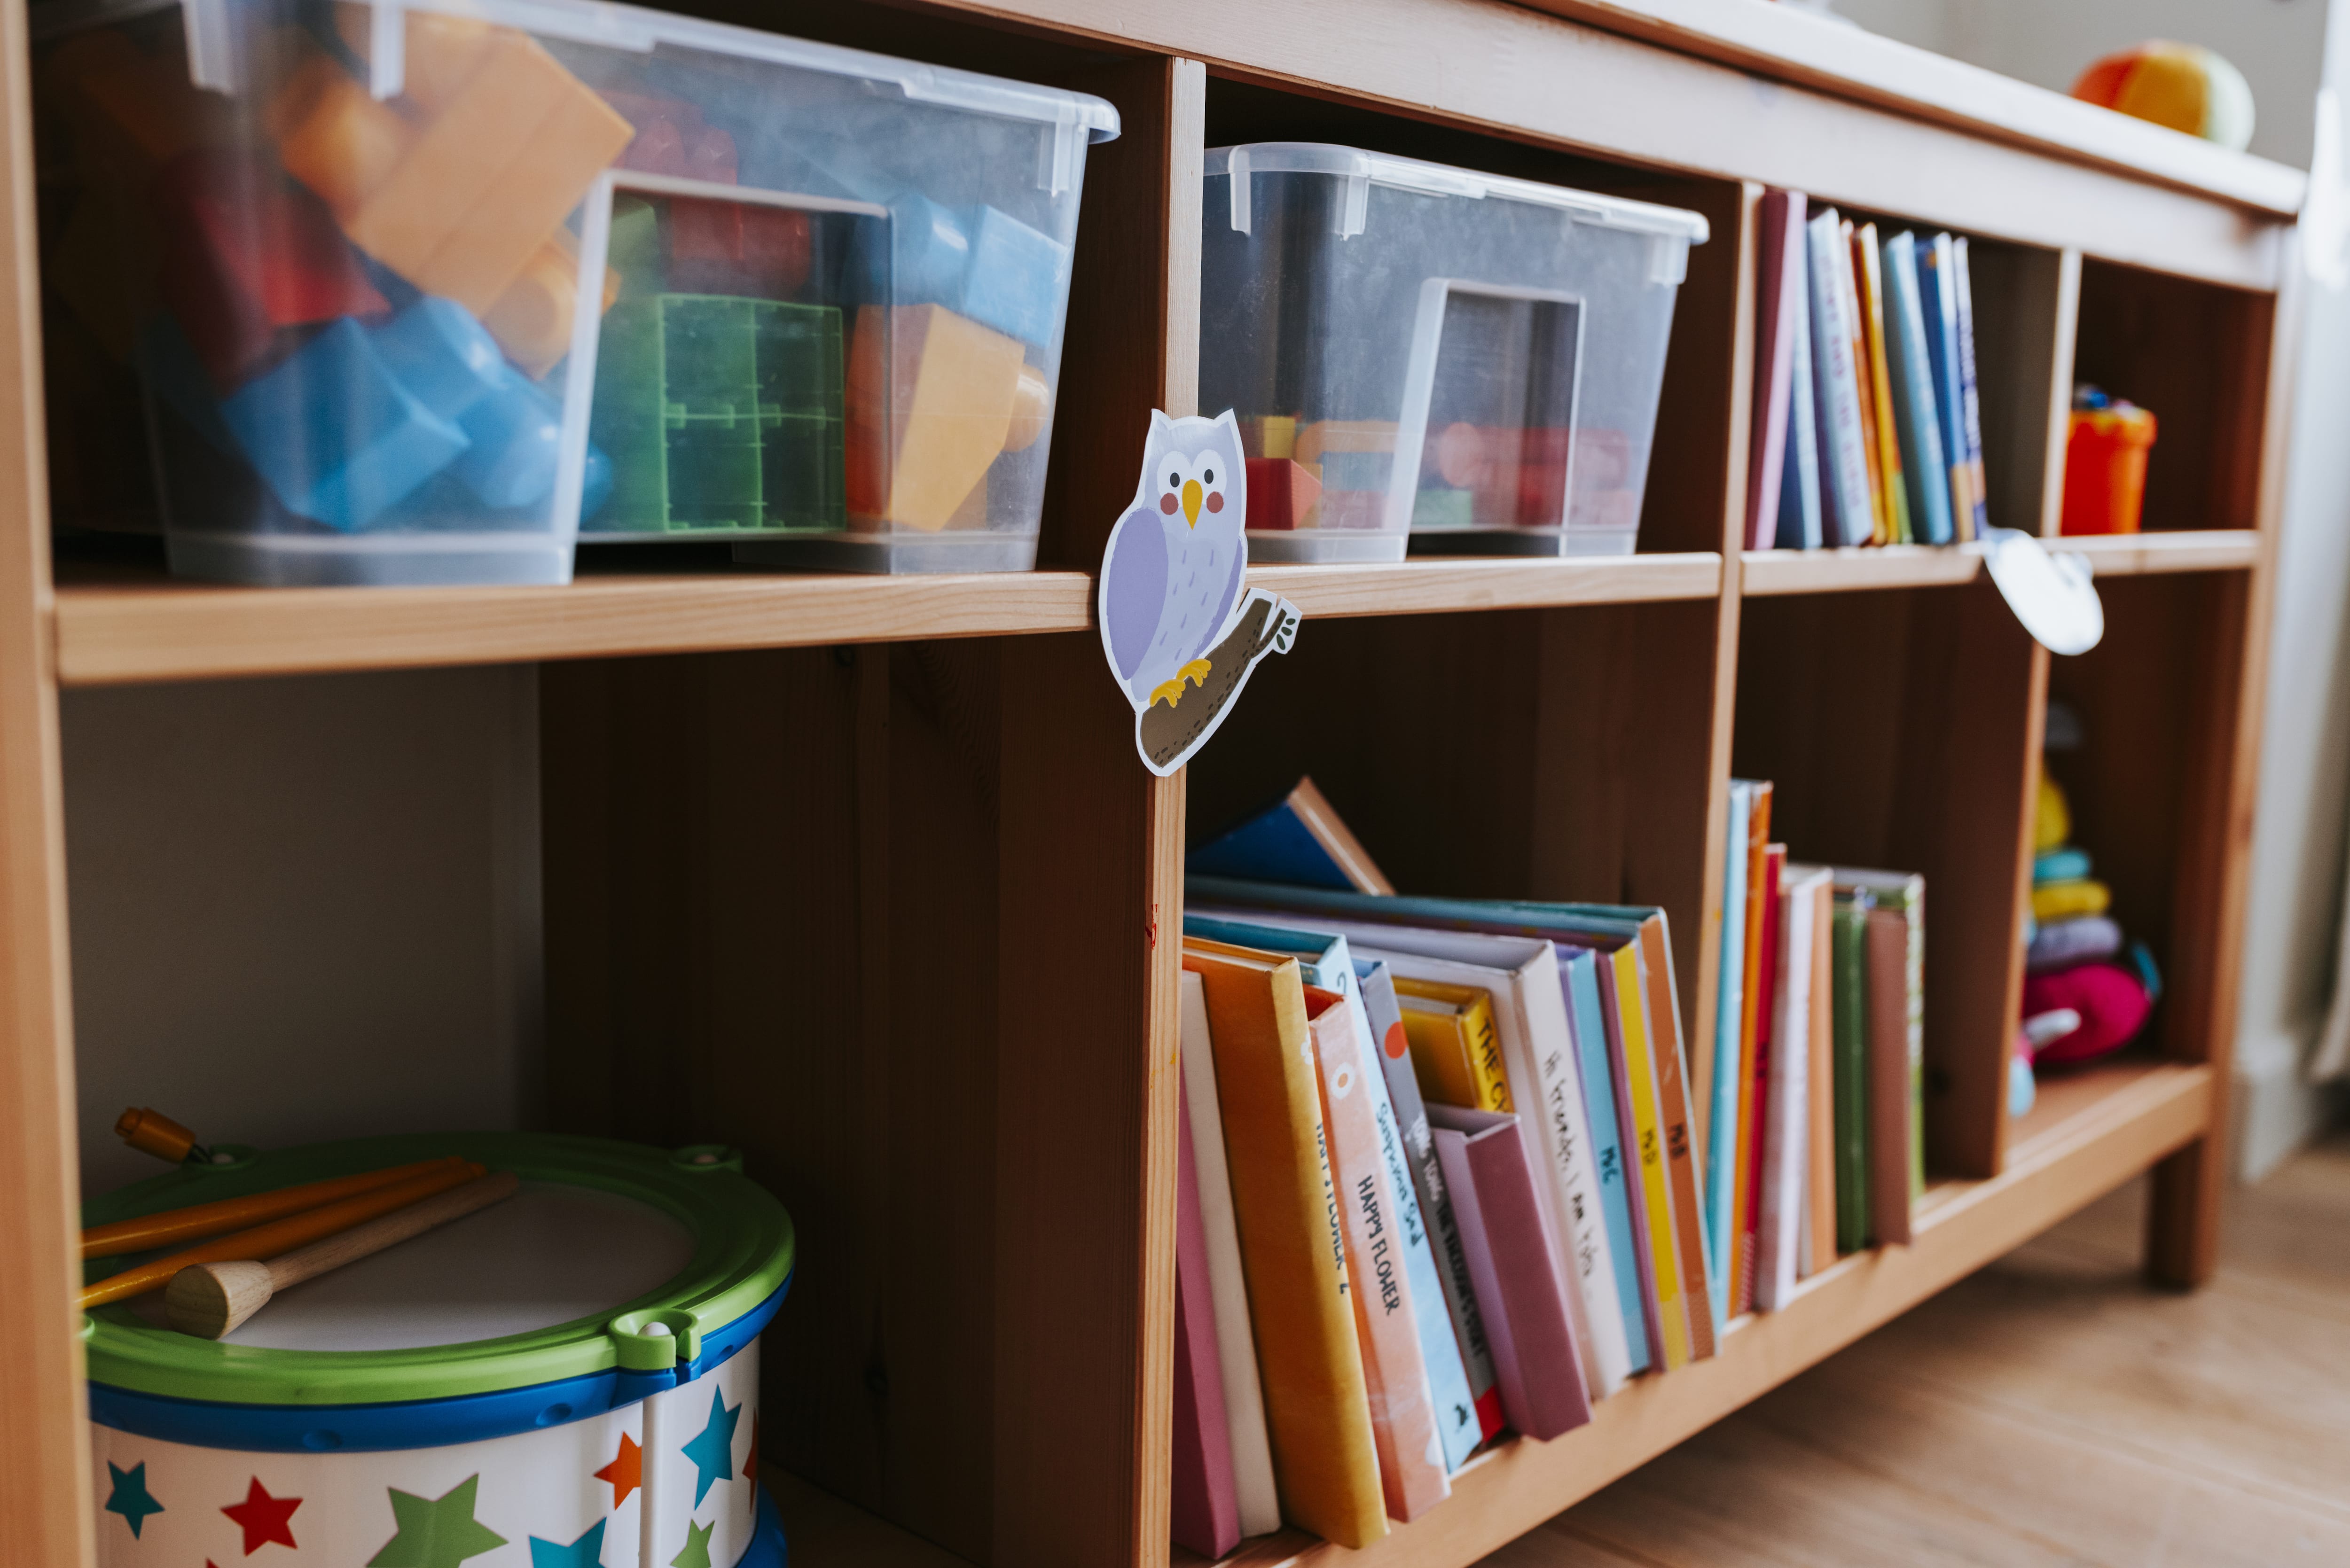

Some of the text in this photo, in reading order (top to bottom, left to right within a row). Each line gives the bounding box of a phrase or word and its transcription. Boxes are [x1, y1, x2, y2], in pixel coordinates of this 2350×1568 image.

[1479, 1017, 1499, 1080] THE
[1358, 1174, 1400, 1316] HAPPY FLOWER
